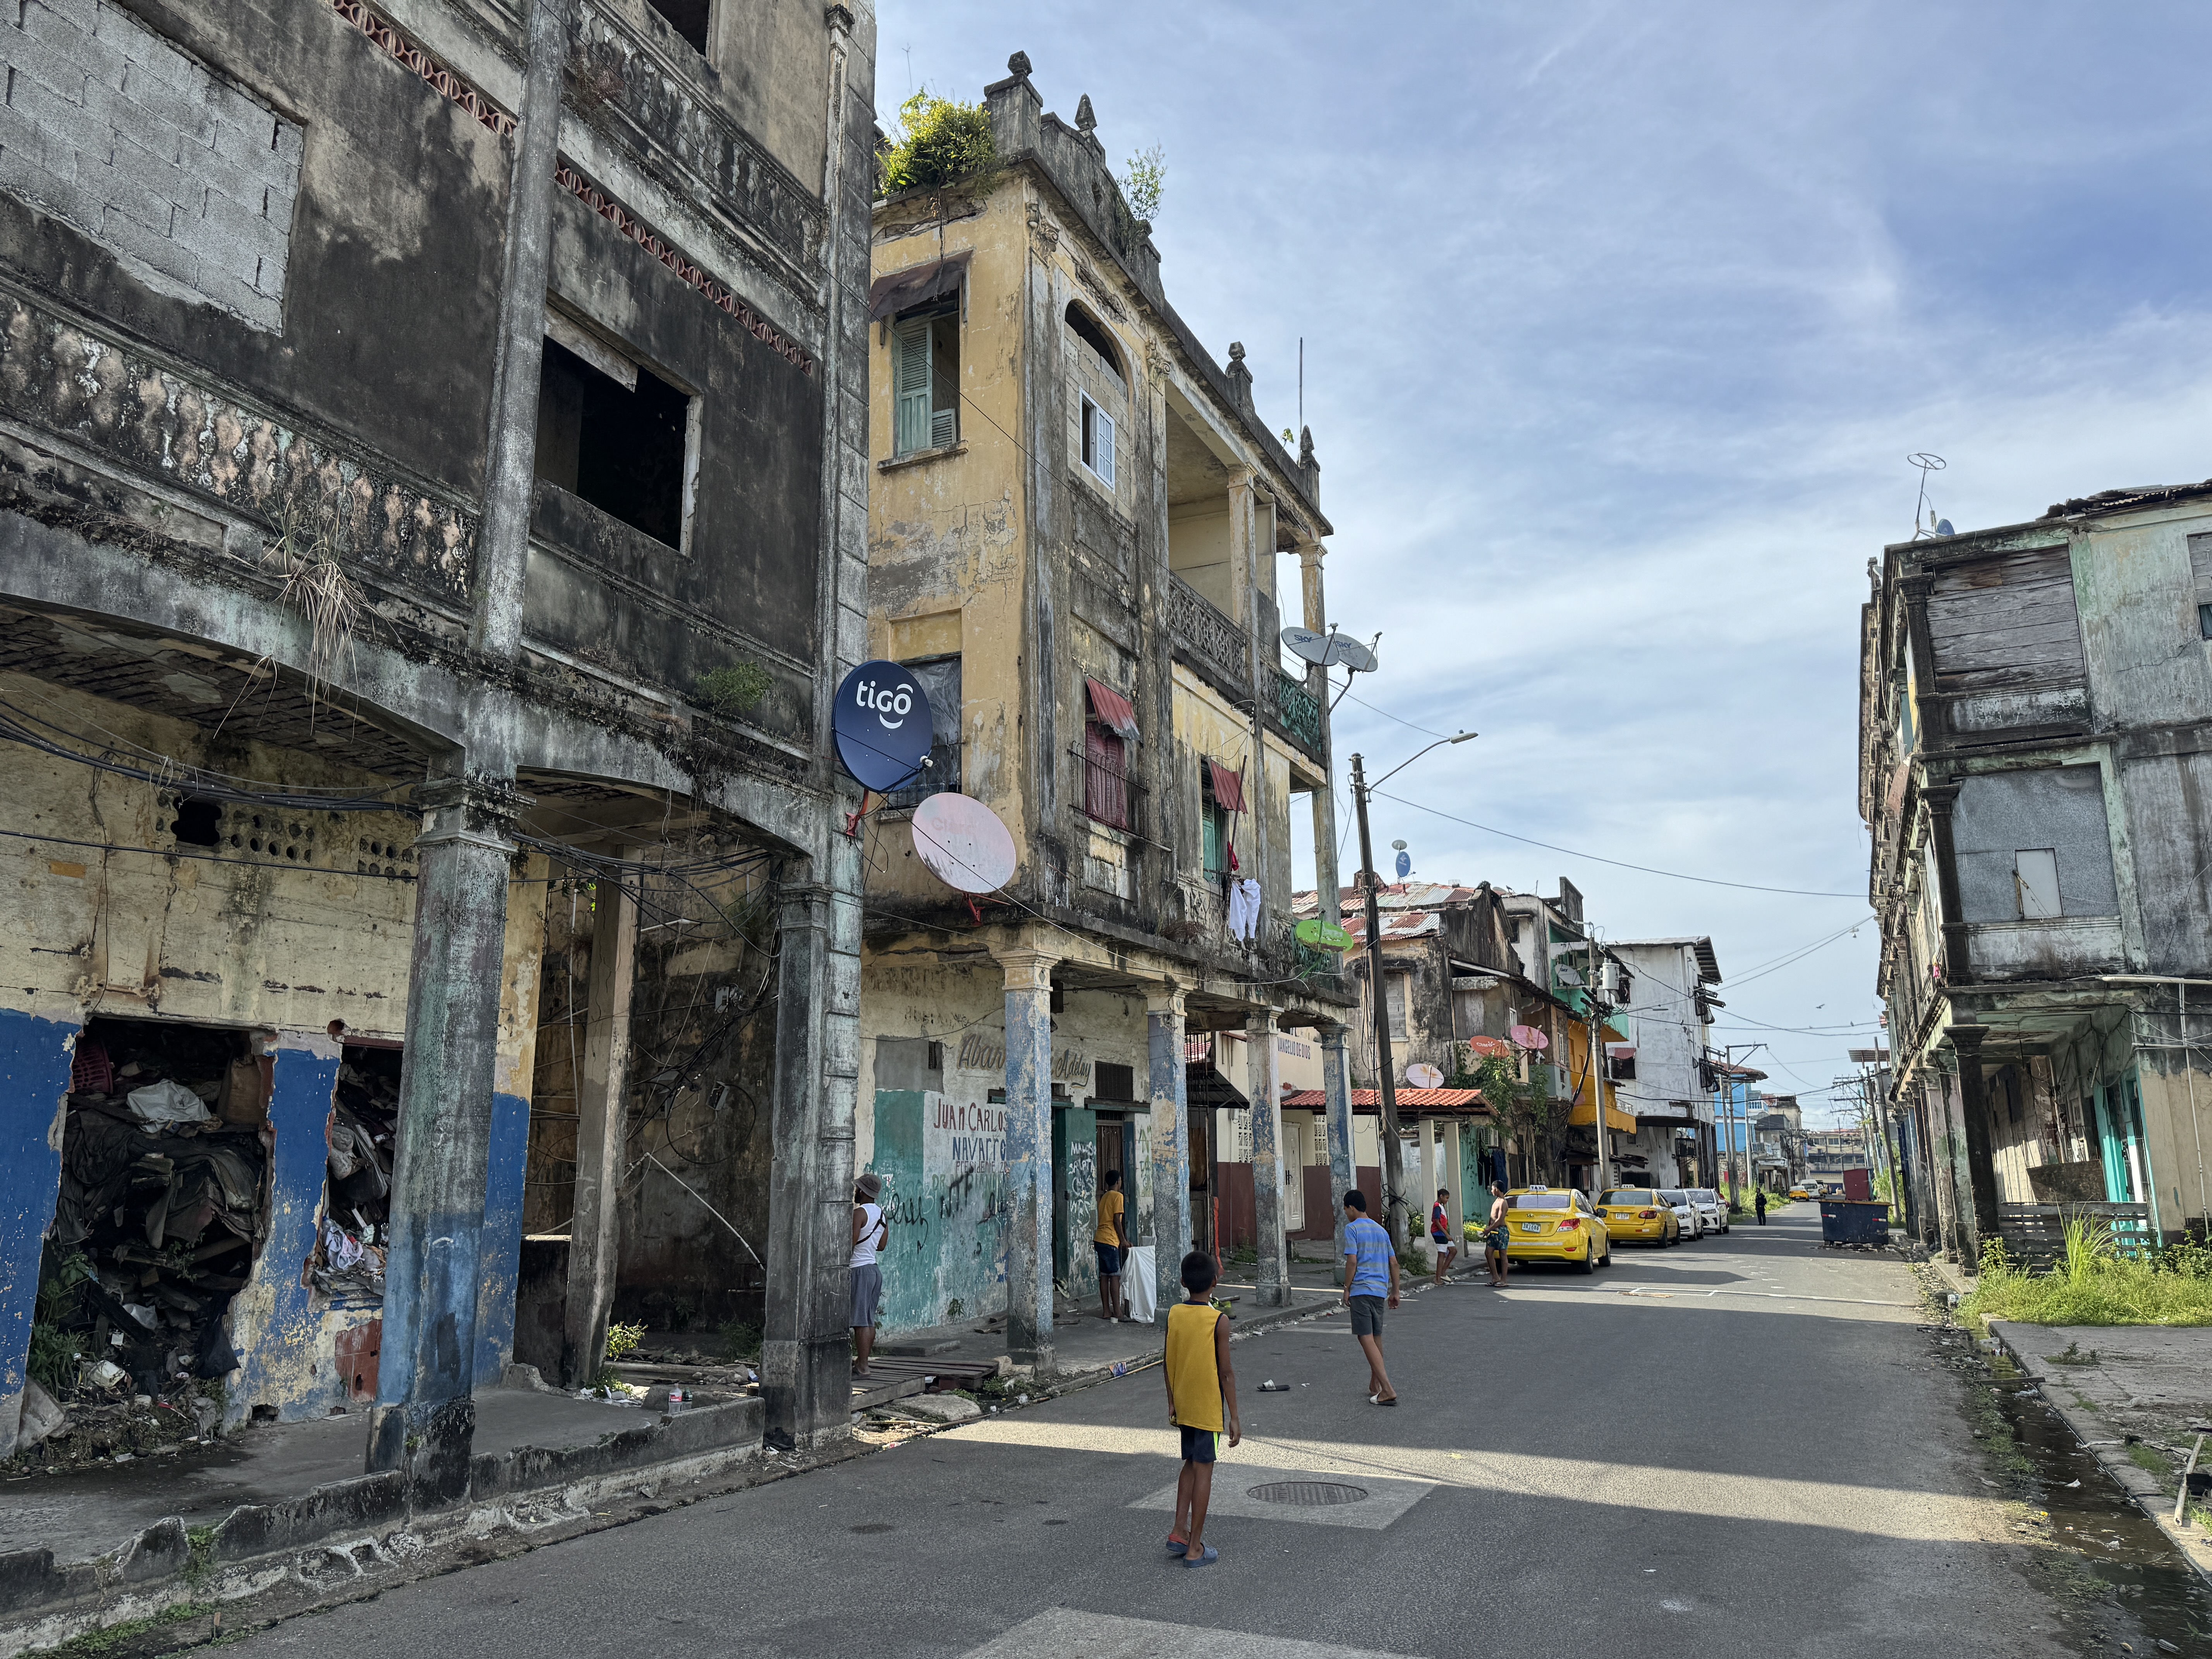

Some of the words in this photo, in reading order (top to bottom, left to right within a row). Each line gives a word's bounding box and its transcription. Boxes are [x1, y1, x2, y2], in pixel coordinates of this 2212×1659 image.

[1294, 634, 1312, 643] SKY
[1277, 1036, 1296, 1056] VANGELIO
[1296, 1042, 1301, 1057] DE
[1302, 1043, 1310, 1060] DIOS
